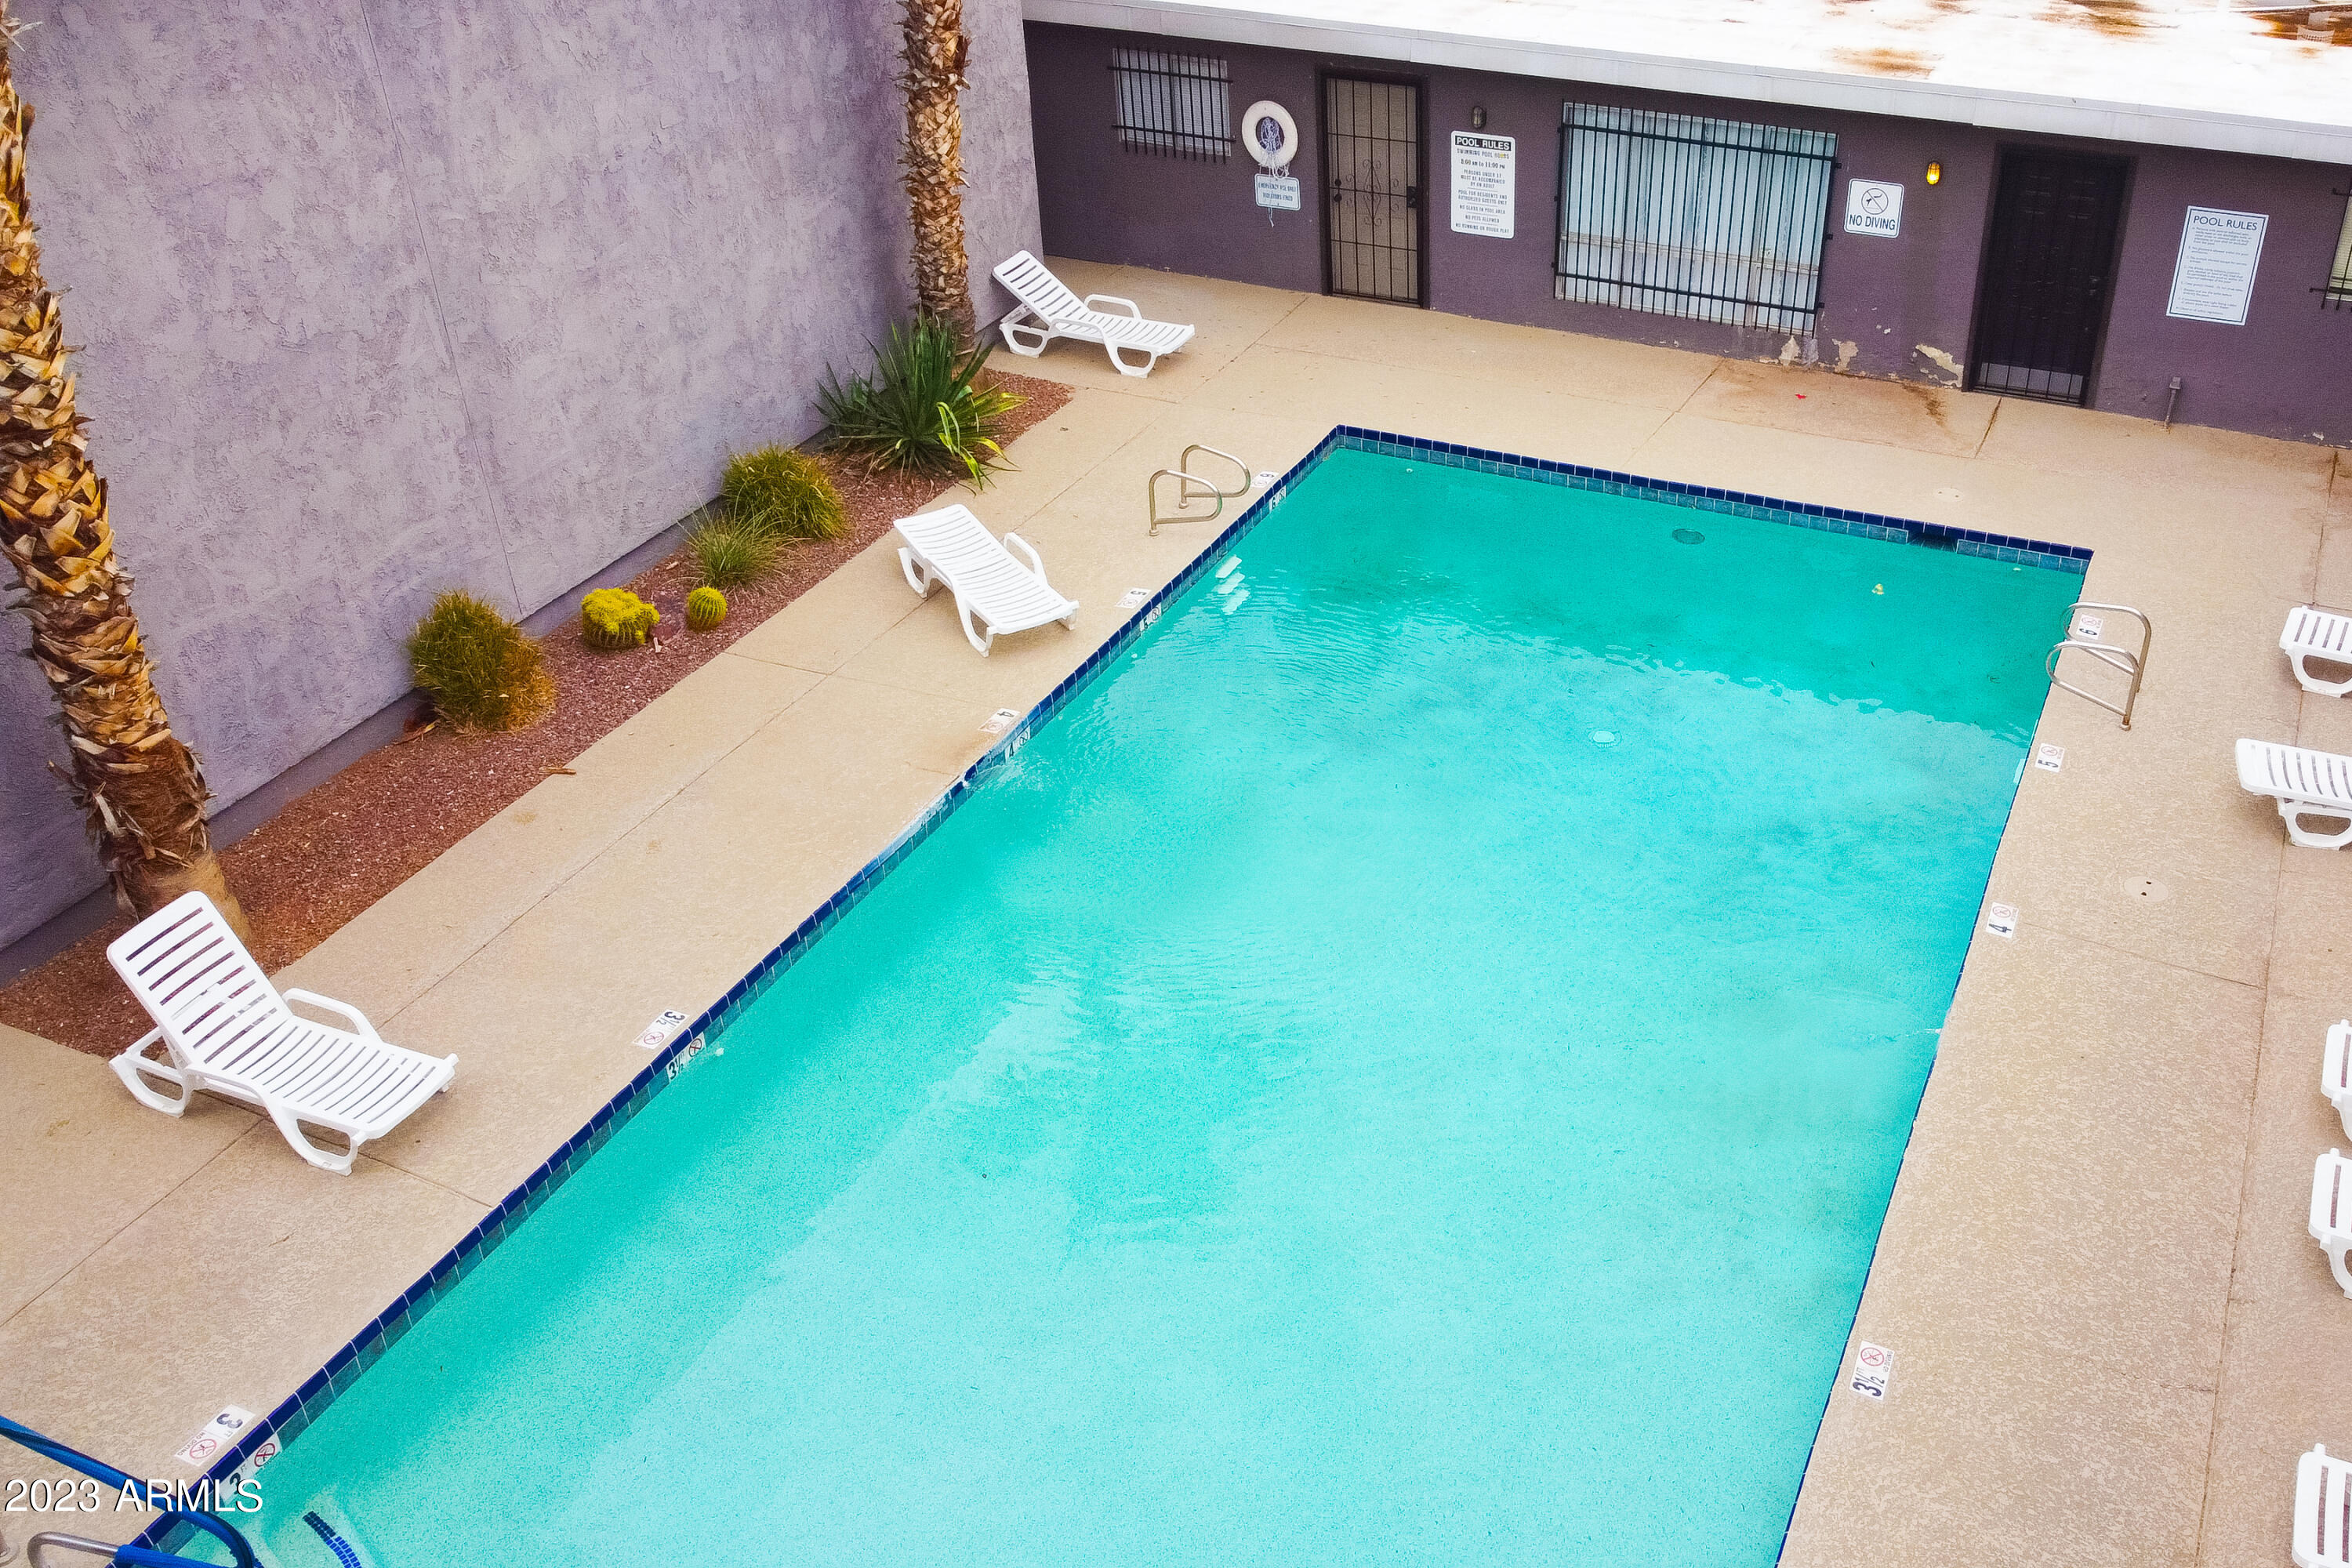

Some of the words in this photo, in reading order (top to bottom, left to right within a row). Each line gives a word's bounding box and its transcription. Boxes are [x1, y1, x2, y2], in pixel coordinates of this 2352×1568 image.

[1457, 136, 1479, 147] POOL
[1483, 140, 1510, 150] RULES
[1849, 214, 1863, 226] NO
[1865, 216, 1896, 230] DIVING
[2193, 215, 2223, 227] POOL
[2227, 219, 2258, 230] RULES
[1009, 742, 1014, 757] 4
[1988, 924, 2012, 933] 4
[216, 1414, 243, 1428] 3
